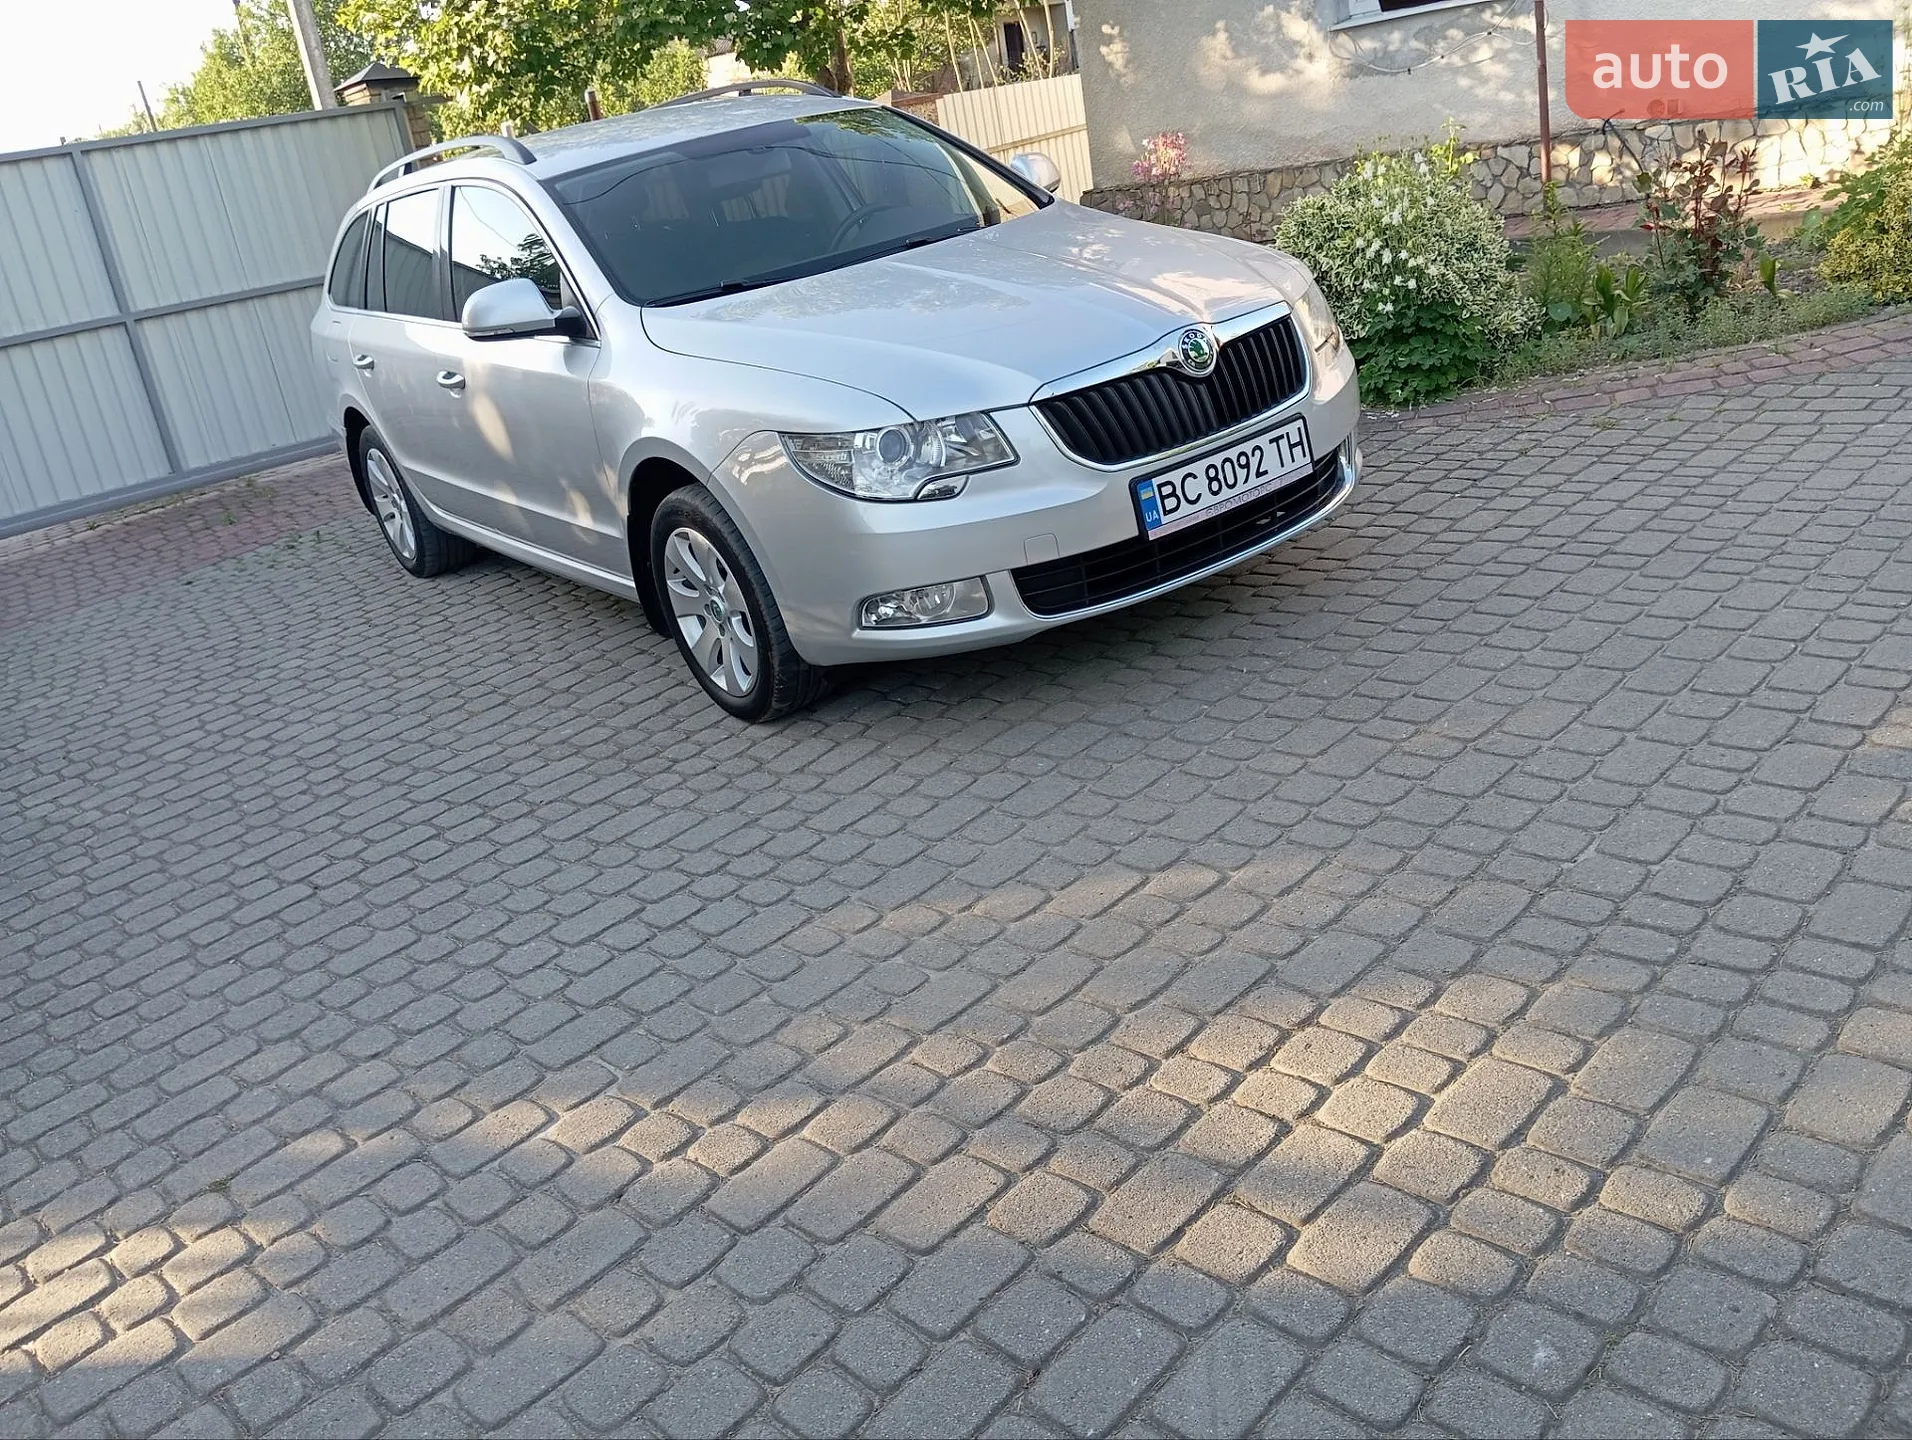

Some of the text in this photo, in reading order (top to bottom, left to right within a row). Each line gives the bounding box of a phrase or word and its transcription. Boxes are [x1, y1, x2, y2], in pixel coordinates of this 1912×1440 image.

[1156, 426, 1306, 517] BC 8092 TH
[1145, 509, 1160, 523] UA
